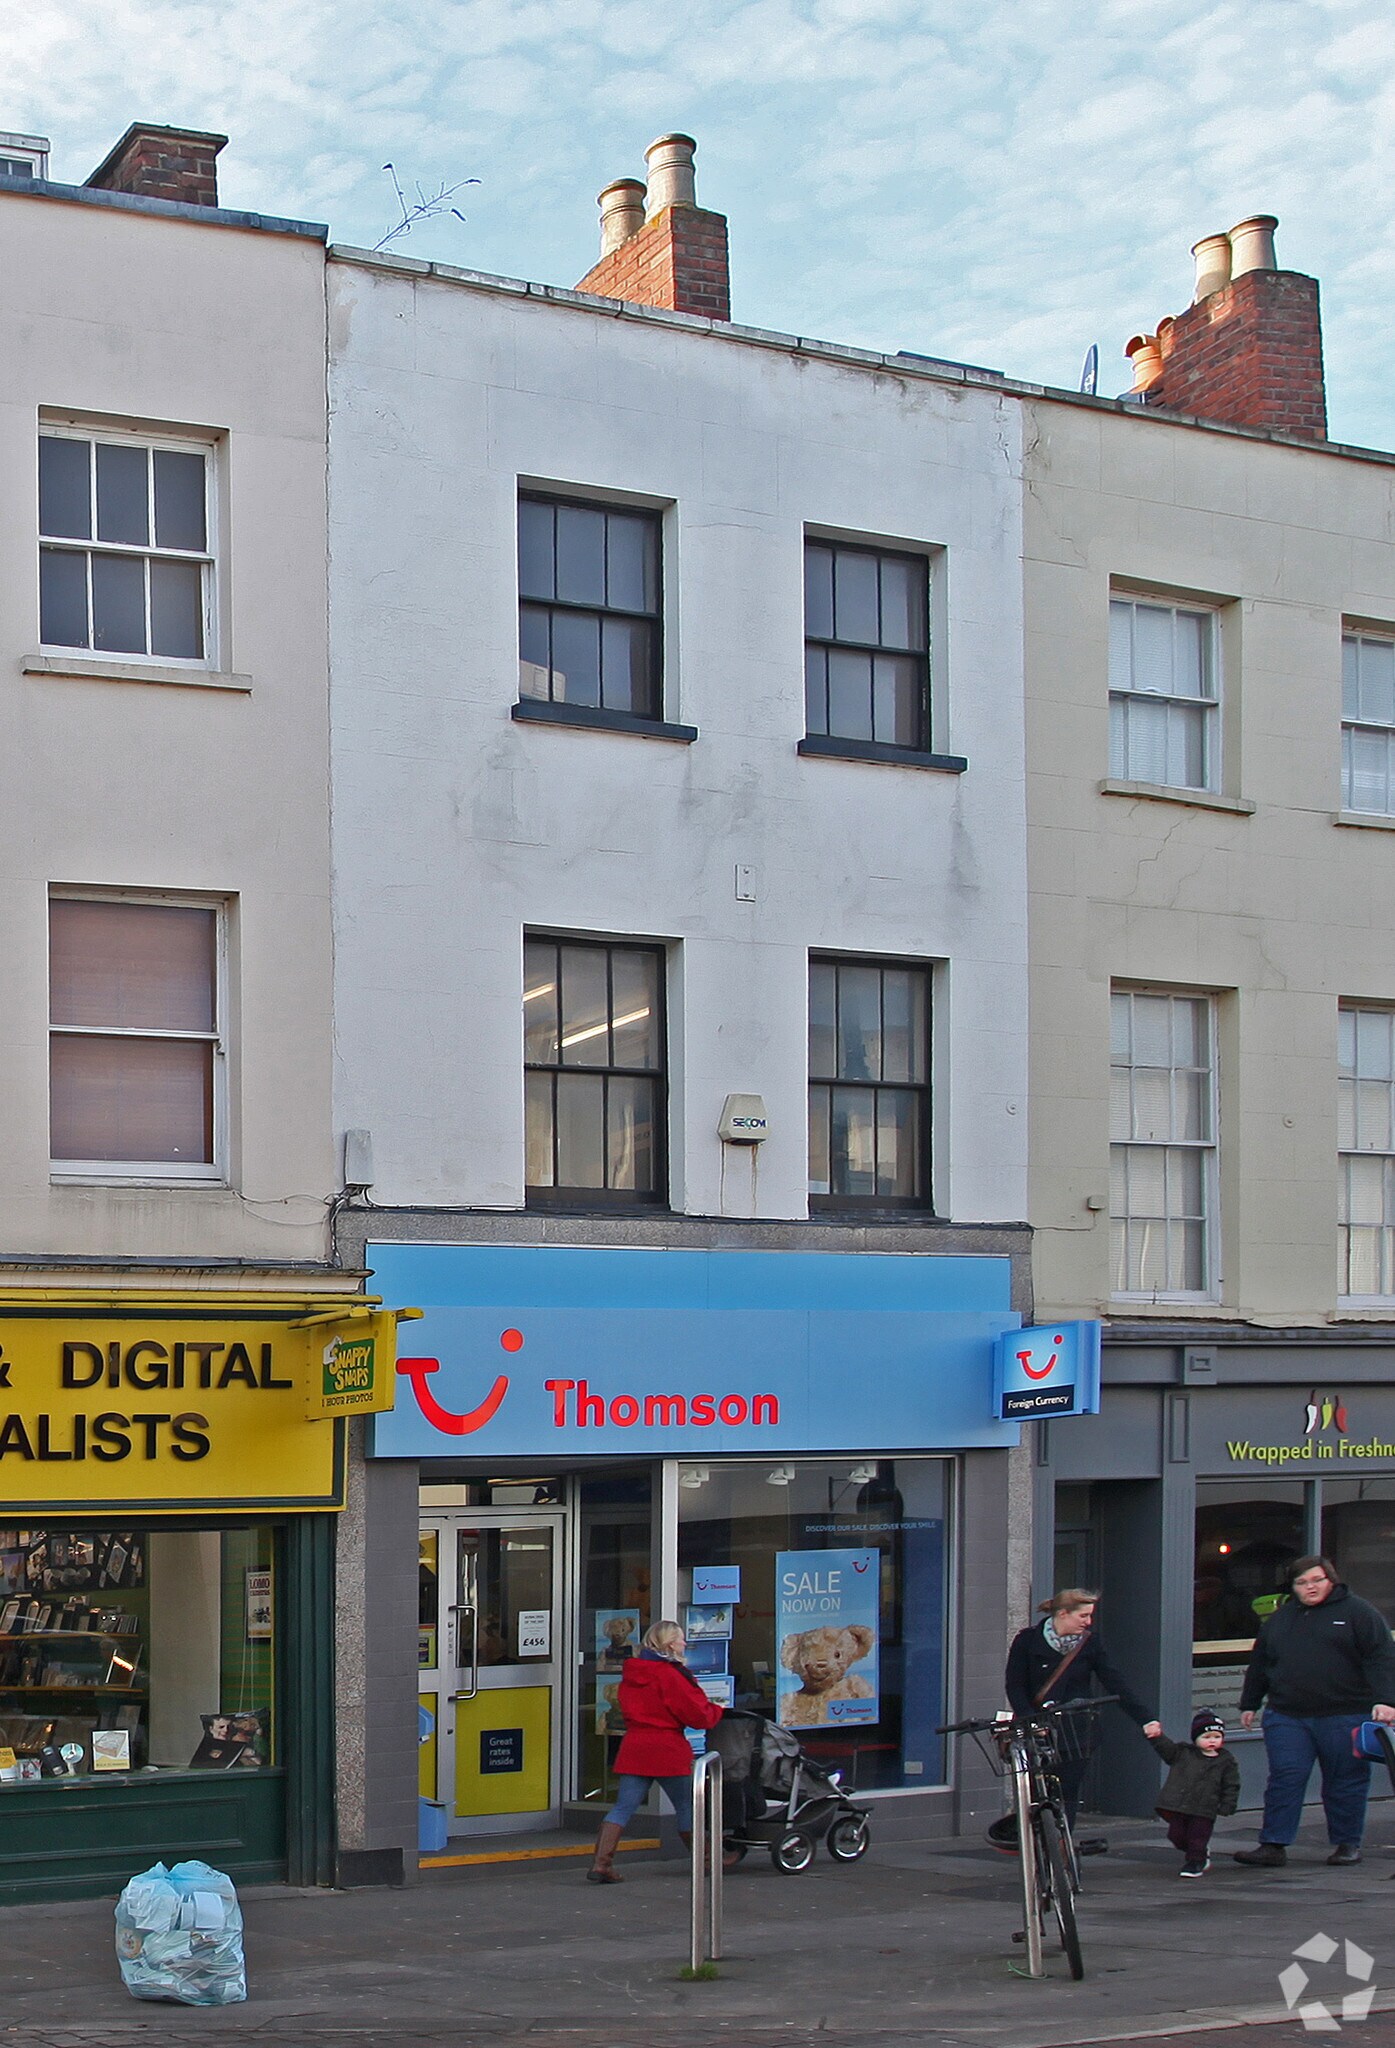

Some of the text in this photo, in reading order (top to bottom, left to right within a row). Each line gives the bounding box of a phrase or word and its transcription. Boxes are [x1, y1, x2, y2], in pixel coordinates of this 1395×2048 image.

[732, 1117, 767, 1128] SECOM
[62, 1340, 293, 1390] DIGITAL
[329, 1346, 371, 1375] SNAPPY
[334, 1367, 369, 1391] SNAPS
[326, 1395, 345, 1407] HOUR
[345, 1392, 374, 1405] PHOTOS
[544, 1379, 779, 1427] Thomson
[1008, 1396, 1069, 1409] Foreign Currency
[0, 1412, 211, 1462] ALISTS
[1227, 1439, 1312, 1465] Wrapped
[1317, 1440, 1333, 1459] in
[805, 1525, 836, 1533] DISCOVER
[869, 1523, 899, 1531] DISCOVER
[900, 1522, 917, 1530] YOUR
[783, 1571, 841, 1596] SALE
[782, 1599, 816, 1613] NOW
[820, 1597, 841, 1611] ON
[523, 1637, 545, 1647] £456
[490, 1737, 513, 1747] Great
[489, 1757, 515, 1766] inside
